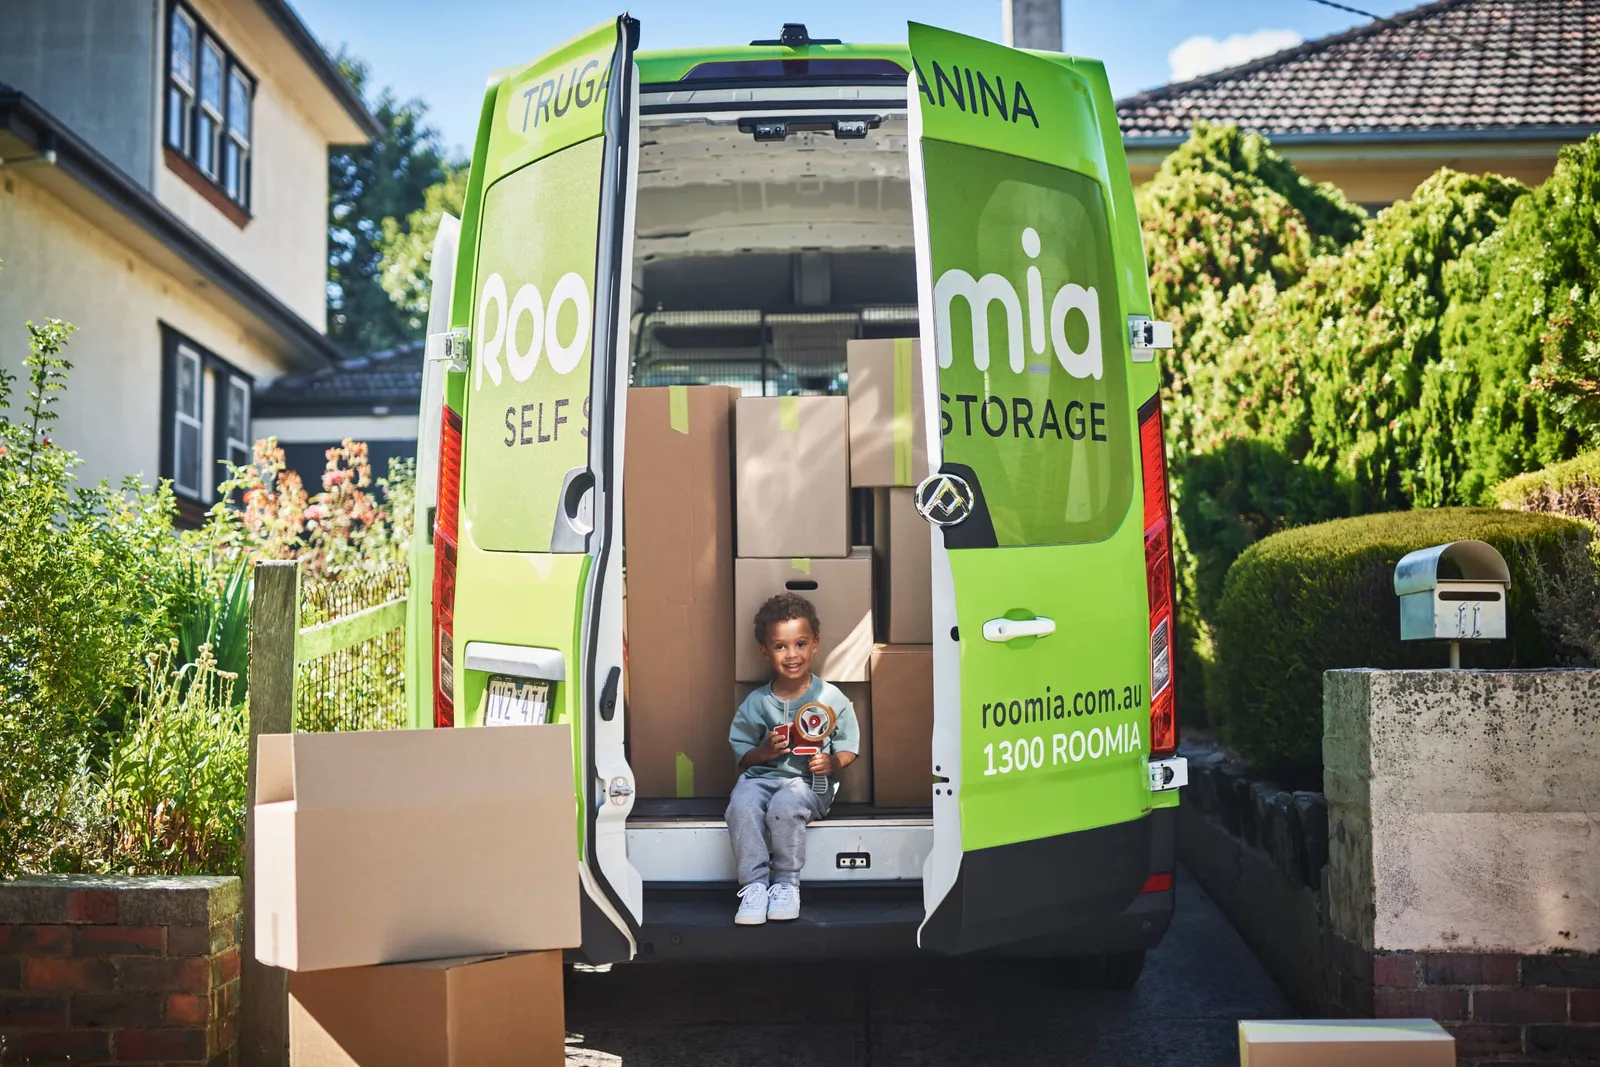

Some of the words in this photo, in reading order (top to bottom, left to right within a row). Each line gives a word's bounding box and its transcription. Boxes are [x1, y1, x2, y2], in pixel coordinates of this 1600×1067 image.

[934, 227, 1104, 380] mia
[504, 398, 570, 447] SELF
[940, 392, 1107, 442] STORAGE
[981, 684, 1142, 729] roomia.com.au
[983, 736, 1045, 776] 1300
[1052, 721, 1142, 765] ROOMIA
